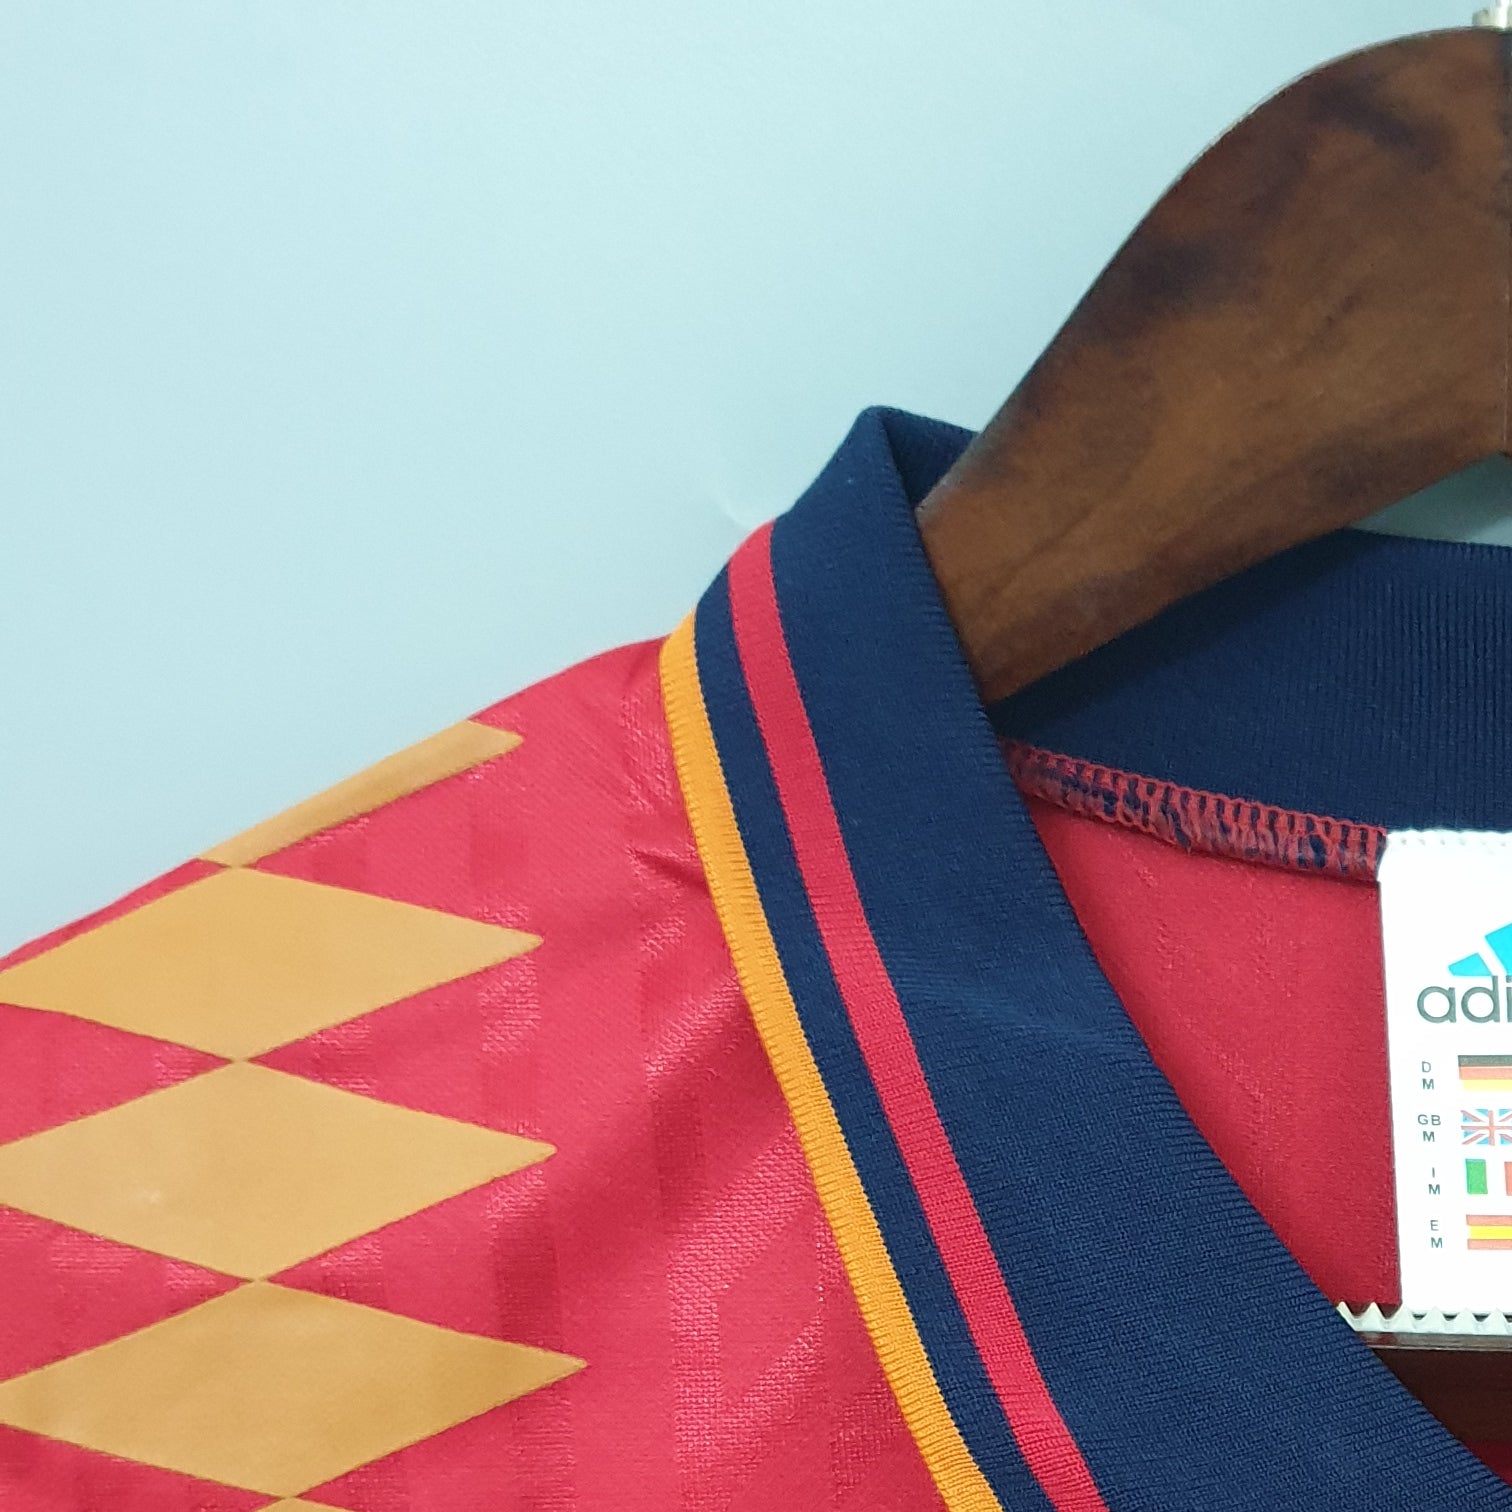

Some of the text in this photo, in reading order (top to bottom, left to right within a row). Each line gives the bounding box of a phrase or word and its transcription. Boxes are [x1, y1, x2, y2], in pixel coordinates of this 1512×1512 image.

[1421, 1060, 1432, 1073] D
[1421, 1077, 1435, 1090] M
[1417, 1113, 1442, 1126] GB
[1422, 1130, 1435, 1143] M
[1427, 1183, 1441, 1195] M
[1429, 1219, 1439, 1232] E
[1430, 1236, 1443, 1249] M
